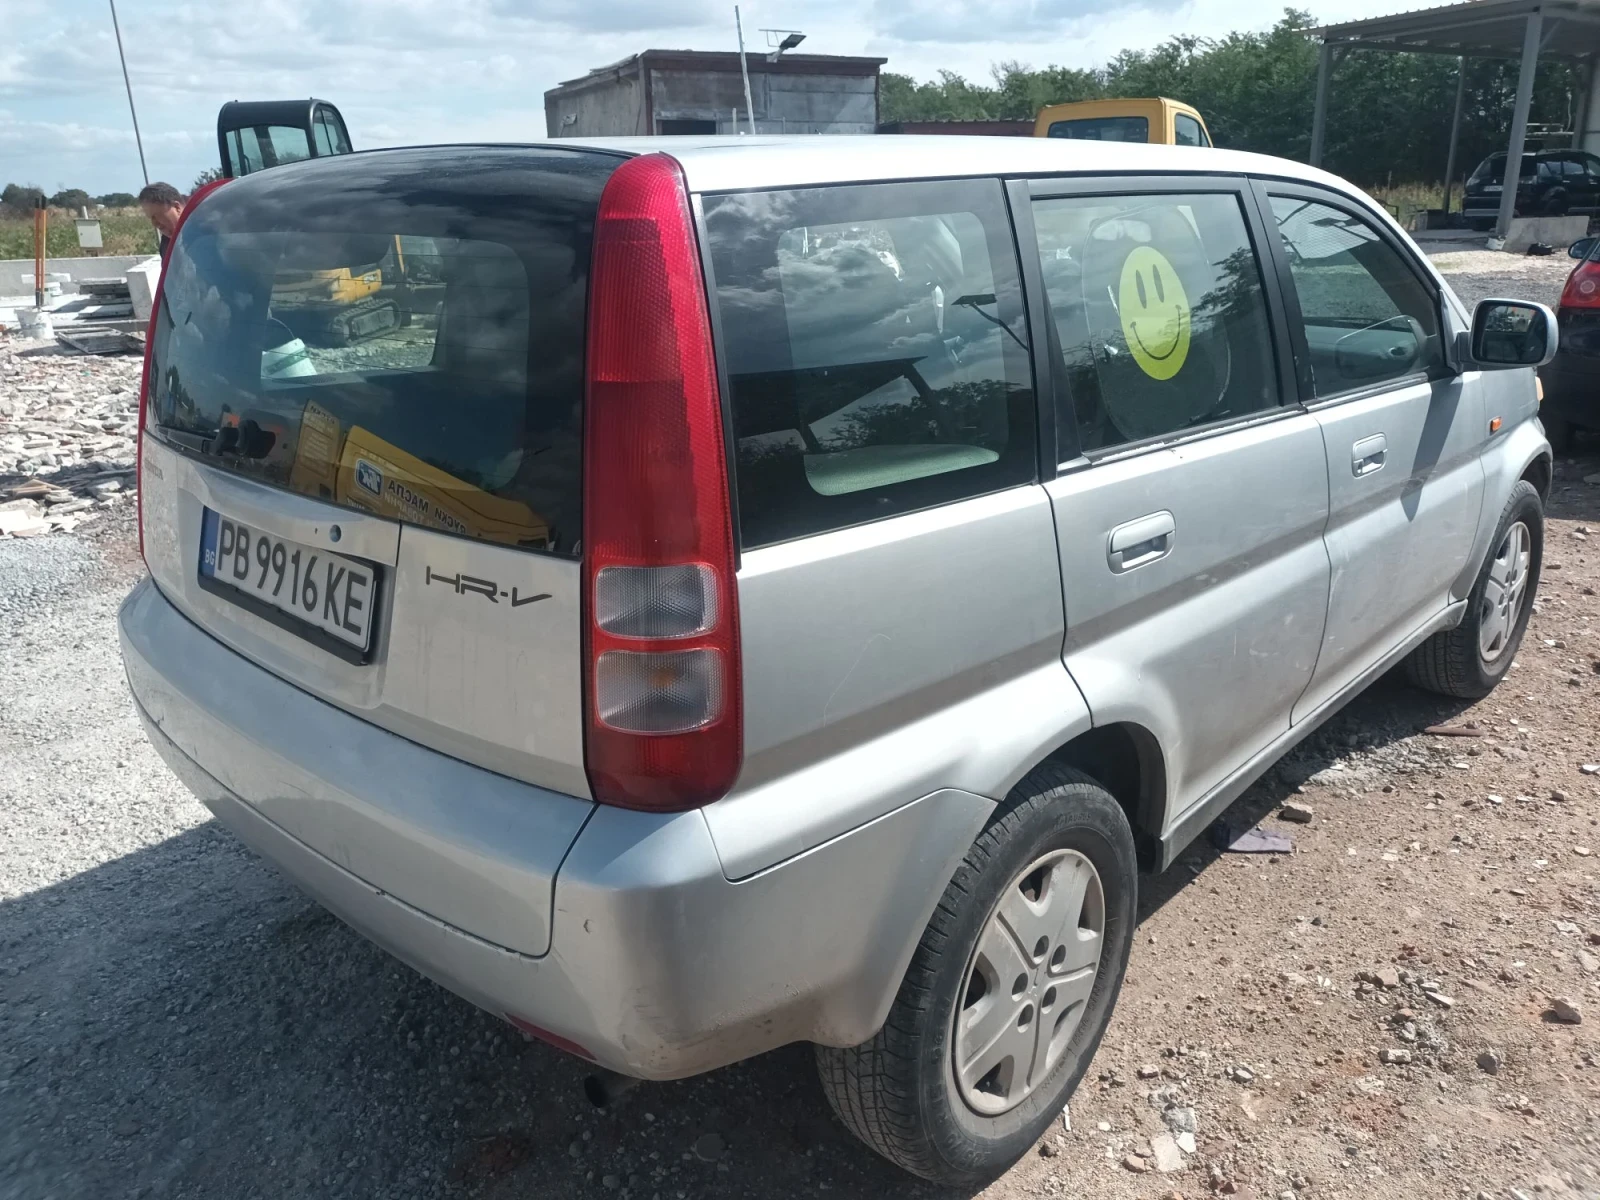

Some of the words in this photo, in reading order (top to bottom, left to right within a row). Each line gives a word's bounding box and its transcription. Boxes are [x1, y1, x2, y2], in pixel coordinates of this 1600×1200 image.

[204, 550, 216, 567] BG
[217, 519, 250, 581] PB
[256, 535, 318, 612] 9916
[323, 561, 367, 636] KE
[425, 565, 553, 607] HR-V
